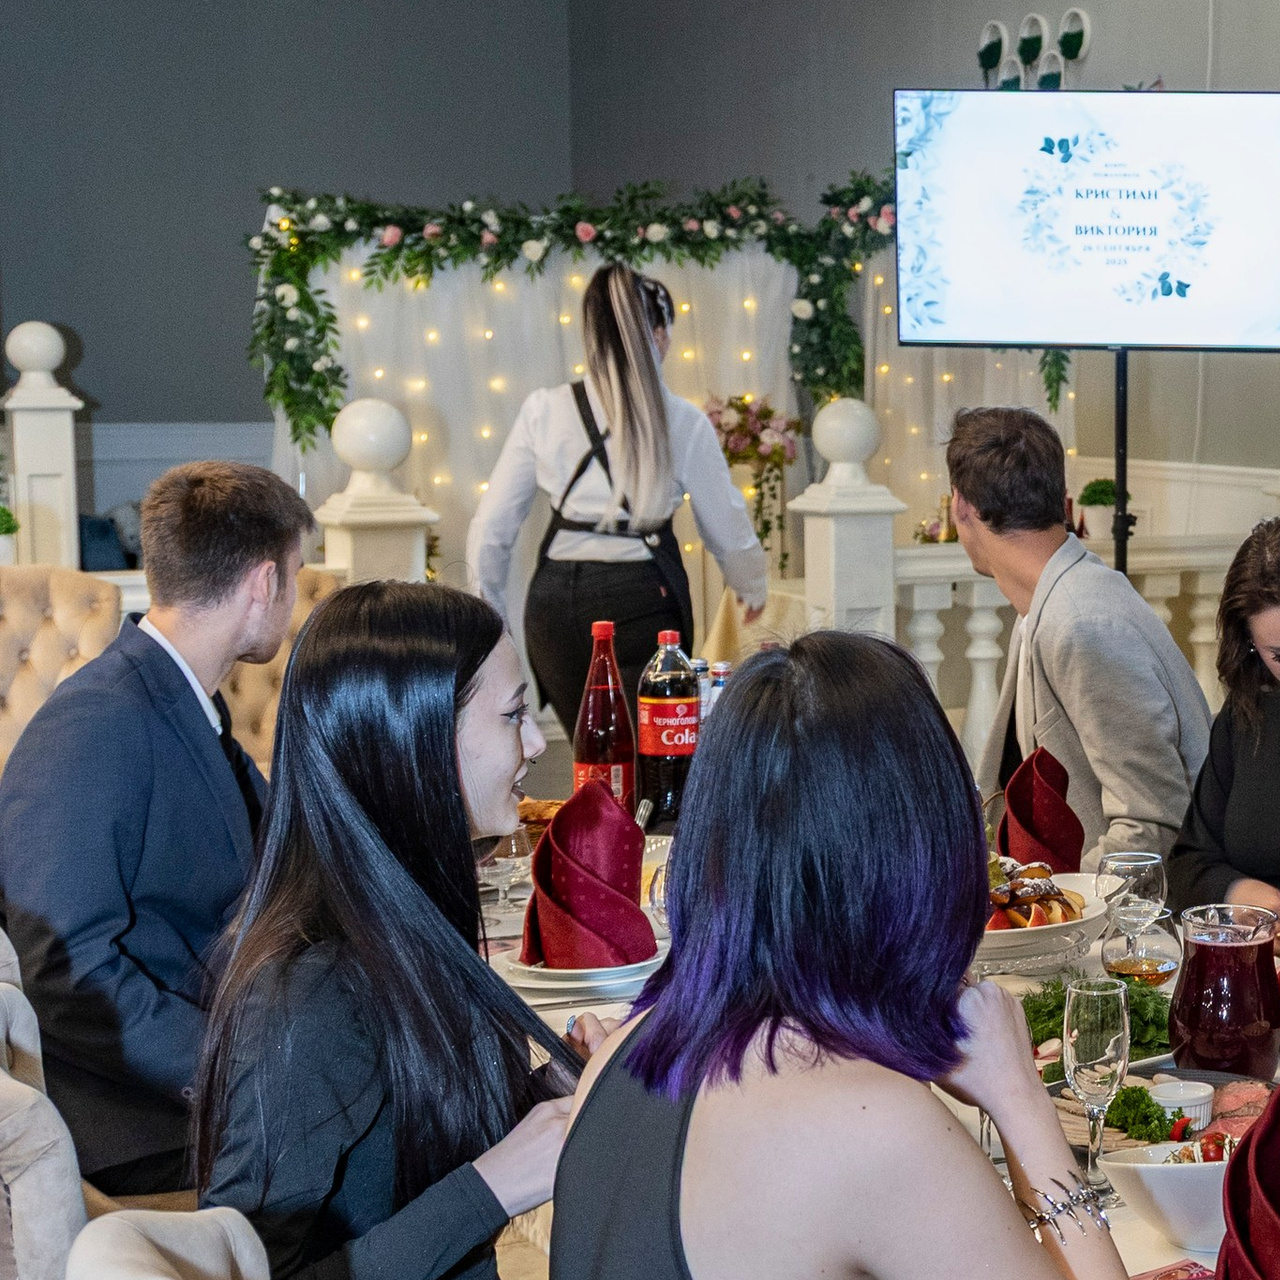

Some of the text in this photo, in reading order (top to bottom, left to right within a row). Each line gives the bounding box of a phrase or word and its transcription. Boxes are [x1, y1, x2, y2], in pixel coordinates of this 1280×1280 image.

[1075, 188, 1158, 200] КРИСТИАН
[1075, 225, 1158, 236] ВИКТОРИЯ
[661, 728, 696, 746] Cola
